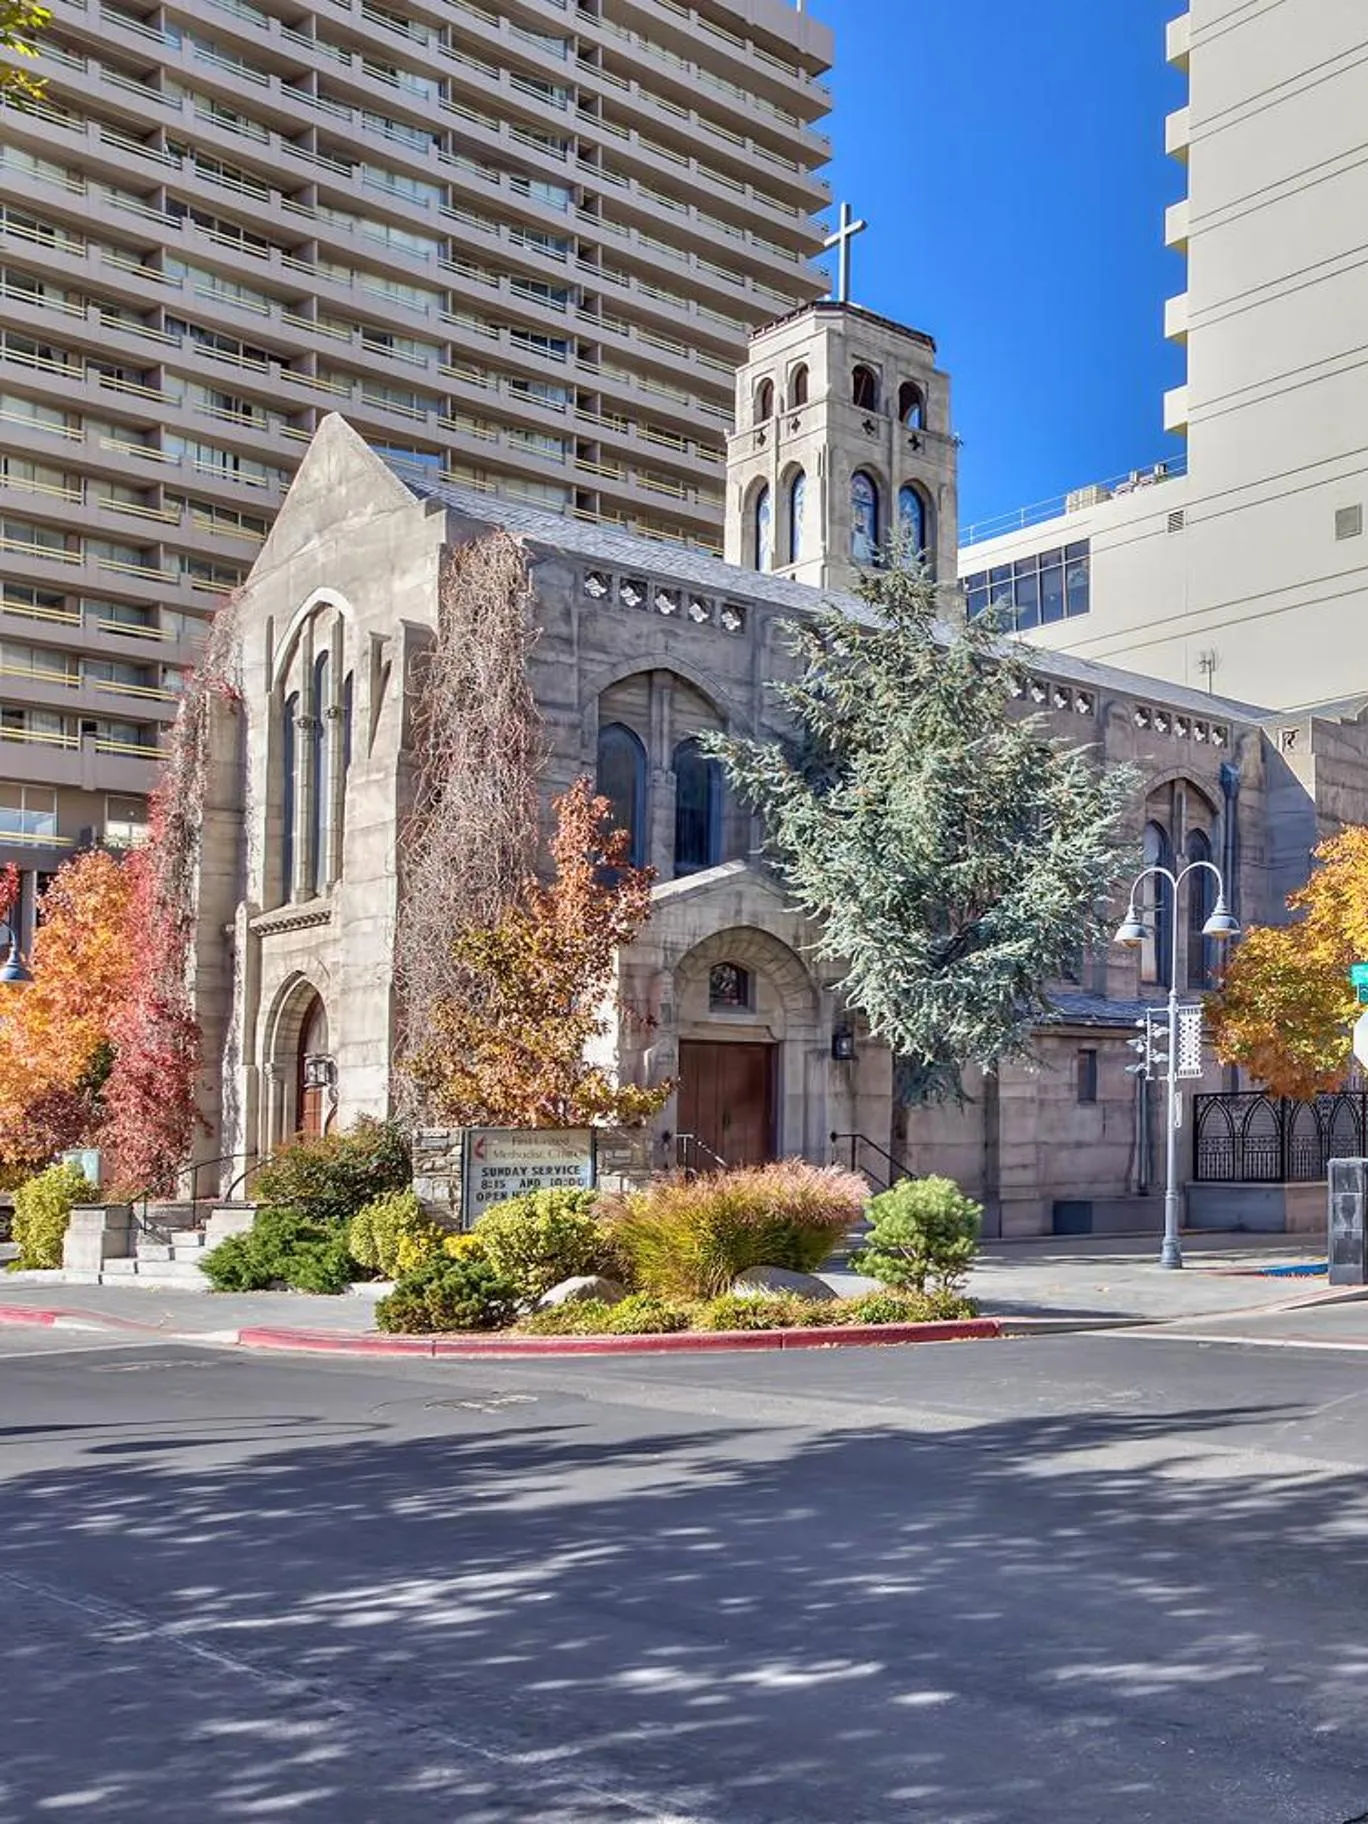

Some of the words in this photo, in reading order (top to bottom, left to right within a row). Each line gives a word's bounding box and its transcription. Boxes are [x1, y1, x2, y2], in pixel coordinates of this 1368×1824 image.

[481, 1166, 528, 1177] SUNDAY
[531, 1165, 581, 1176] SERVICE
[480, 1179, 506, 1190] 8:15
[519, 1178, 541, 1189] AND
[475, 1191, 508, 1201] OPEN
